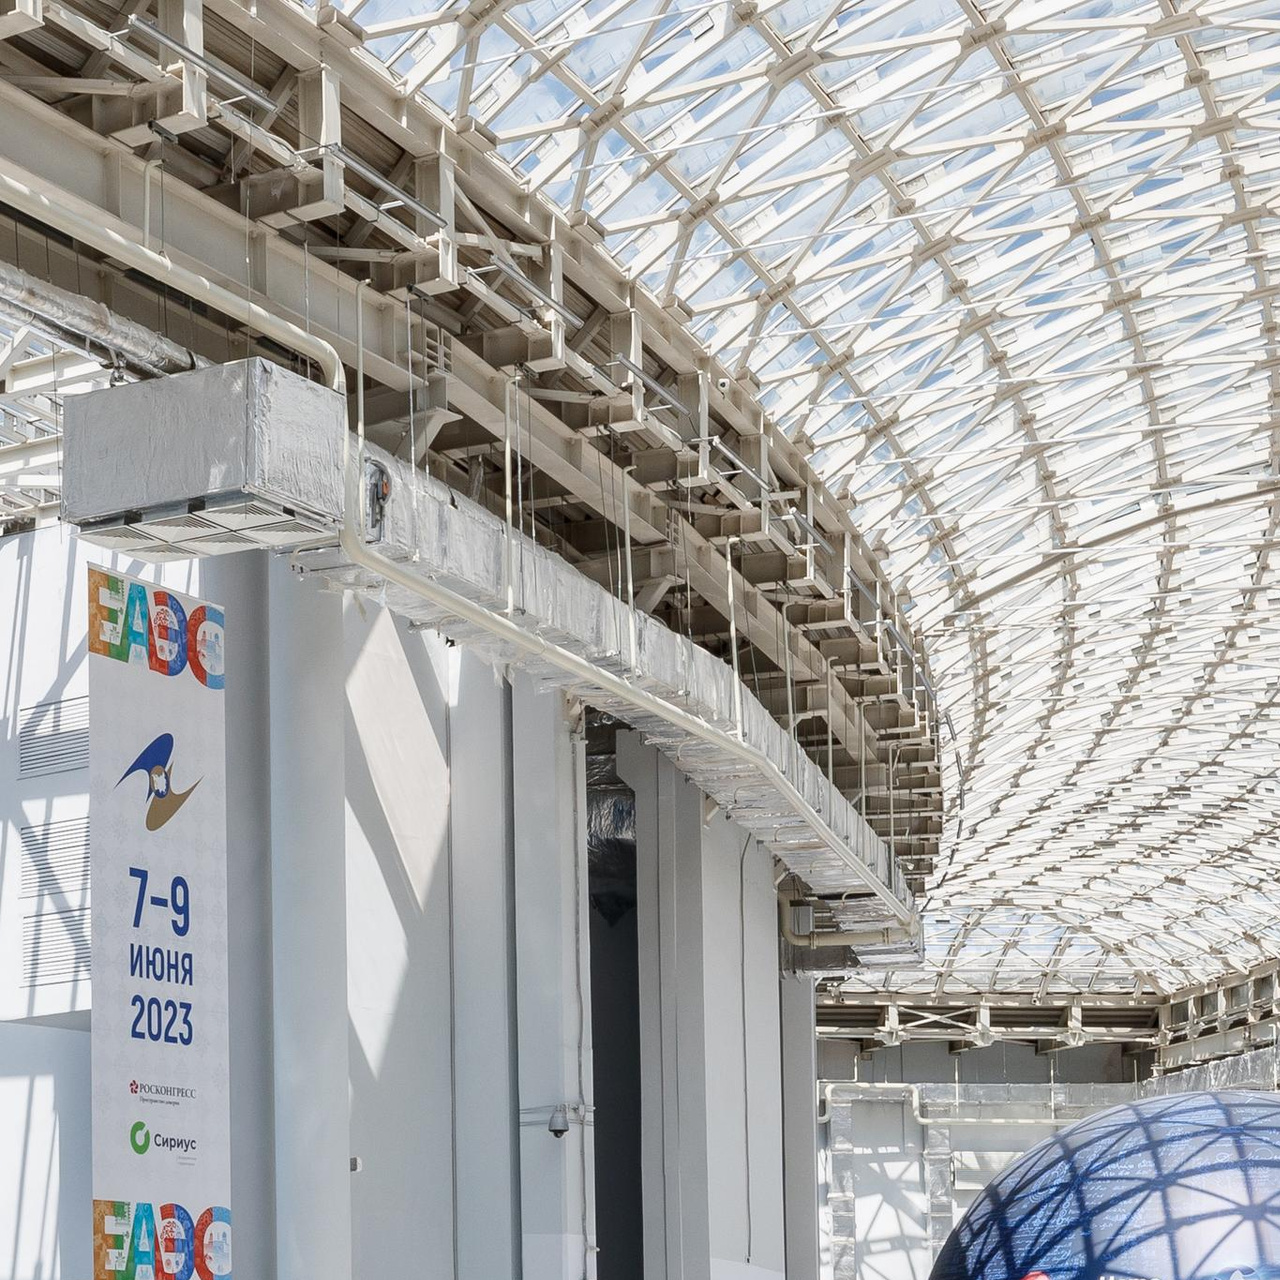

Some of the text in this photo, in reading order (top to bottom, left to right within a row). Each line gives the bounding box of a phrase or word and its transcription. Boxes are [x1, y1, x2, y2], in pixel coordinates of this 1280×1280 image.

[88, 568, 225, 690] ЕАЭС
[130, 943, 194, 986] ИЮНЯ
[131, 994, 194, 1046] 2023
[140, 1083, 197, 1099] РОСКОНГРЕСС
[153, 1133, 197, 1153] Сириус
